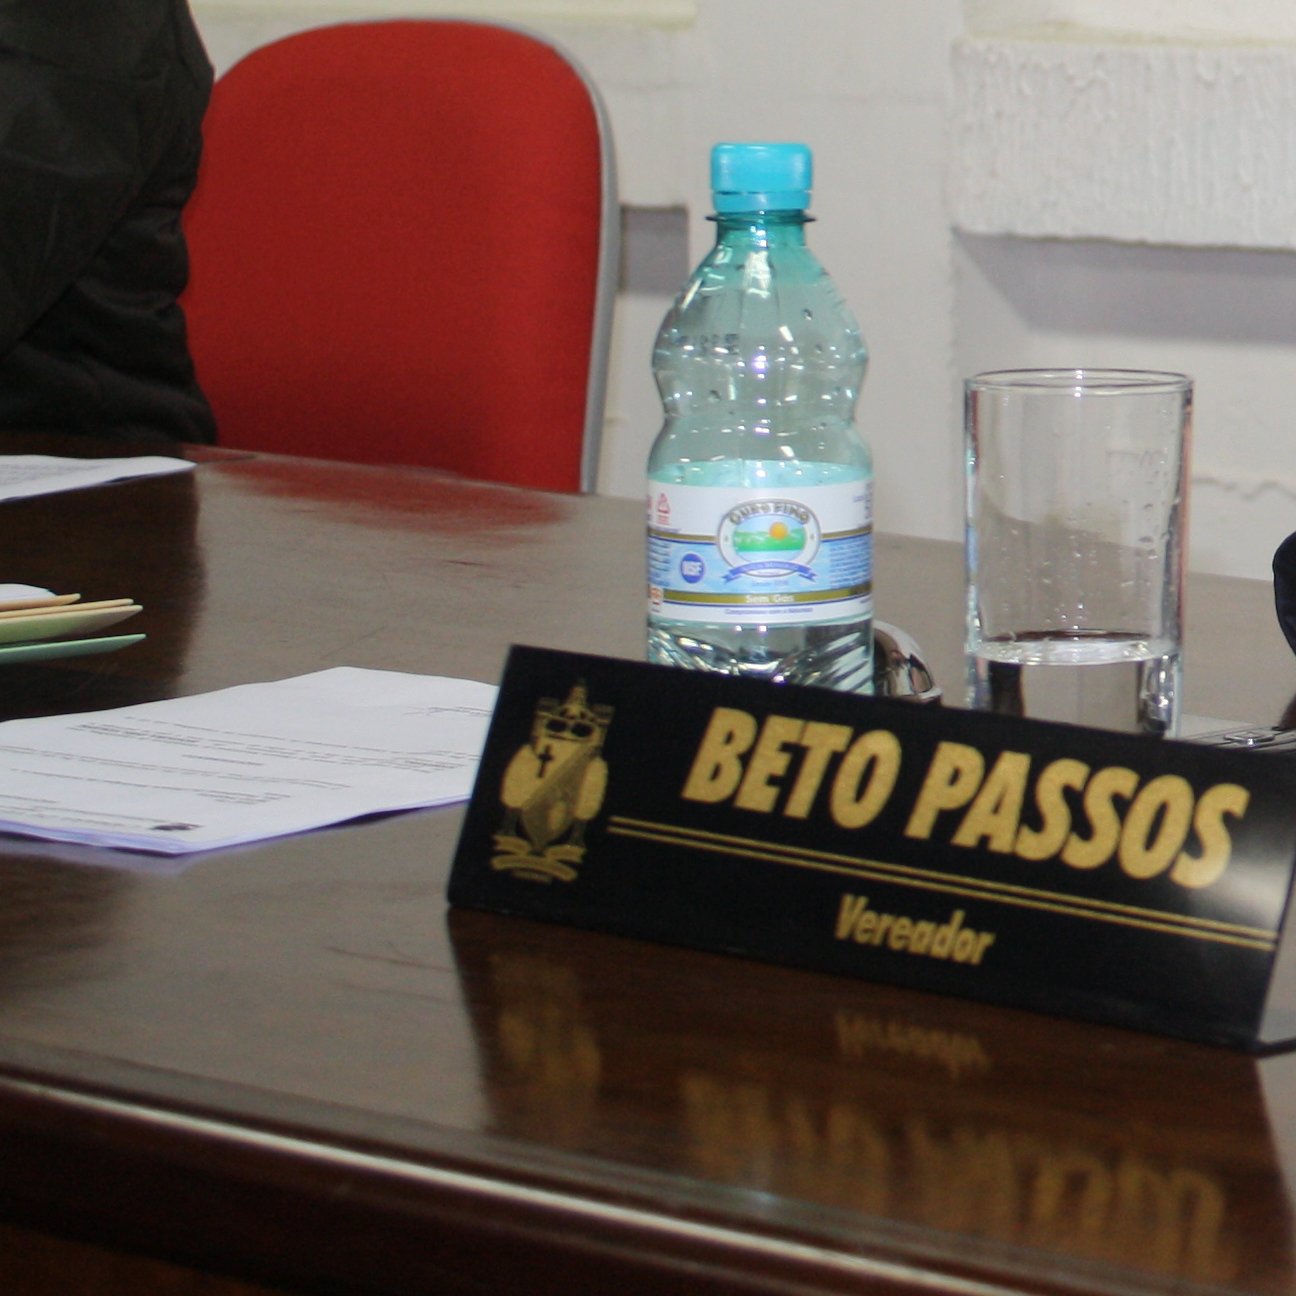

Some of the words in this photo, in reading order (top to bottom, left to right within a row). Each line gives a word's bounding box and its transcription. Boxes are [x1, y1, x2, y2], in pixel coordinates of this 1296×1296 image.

[682, 708, 902, 829] BETO
[905, 741, 1250, 889] PASSOS
[836, 894, 996, 966] Vereador
